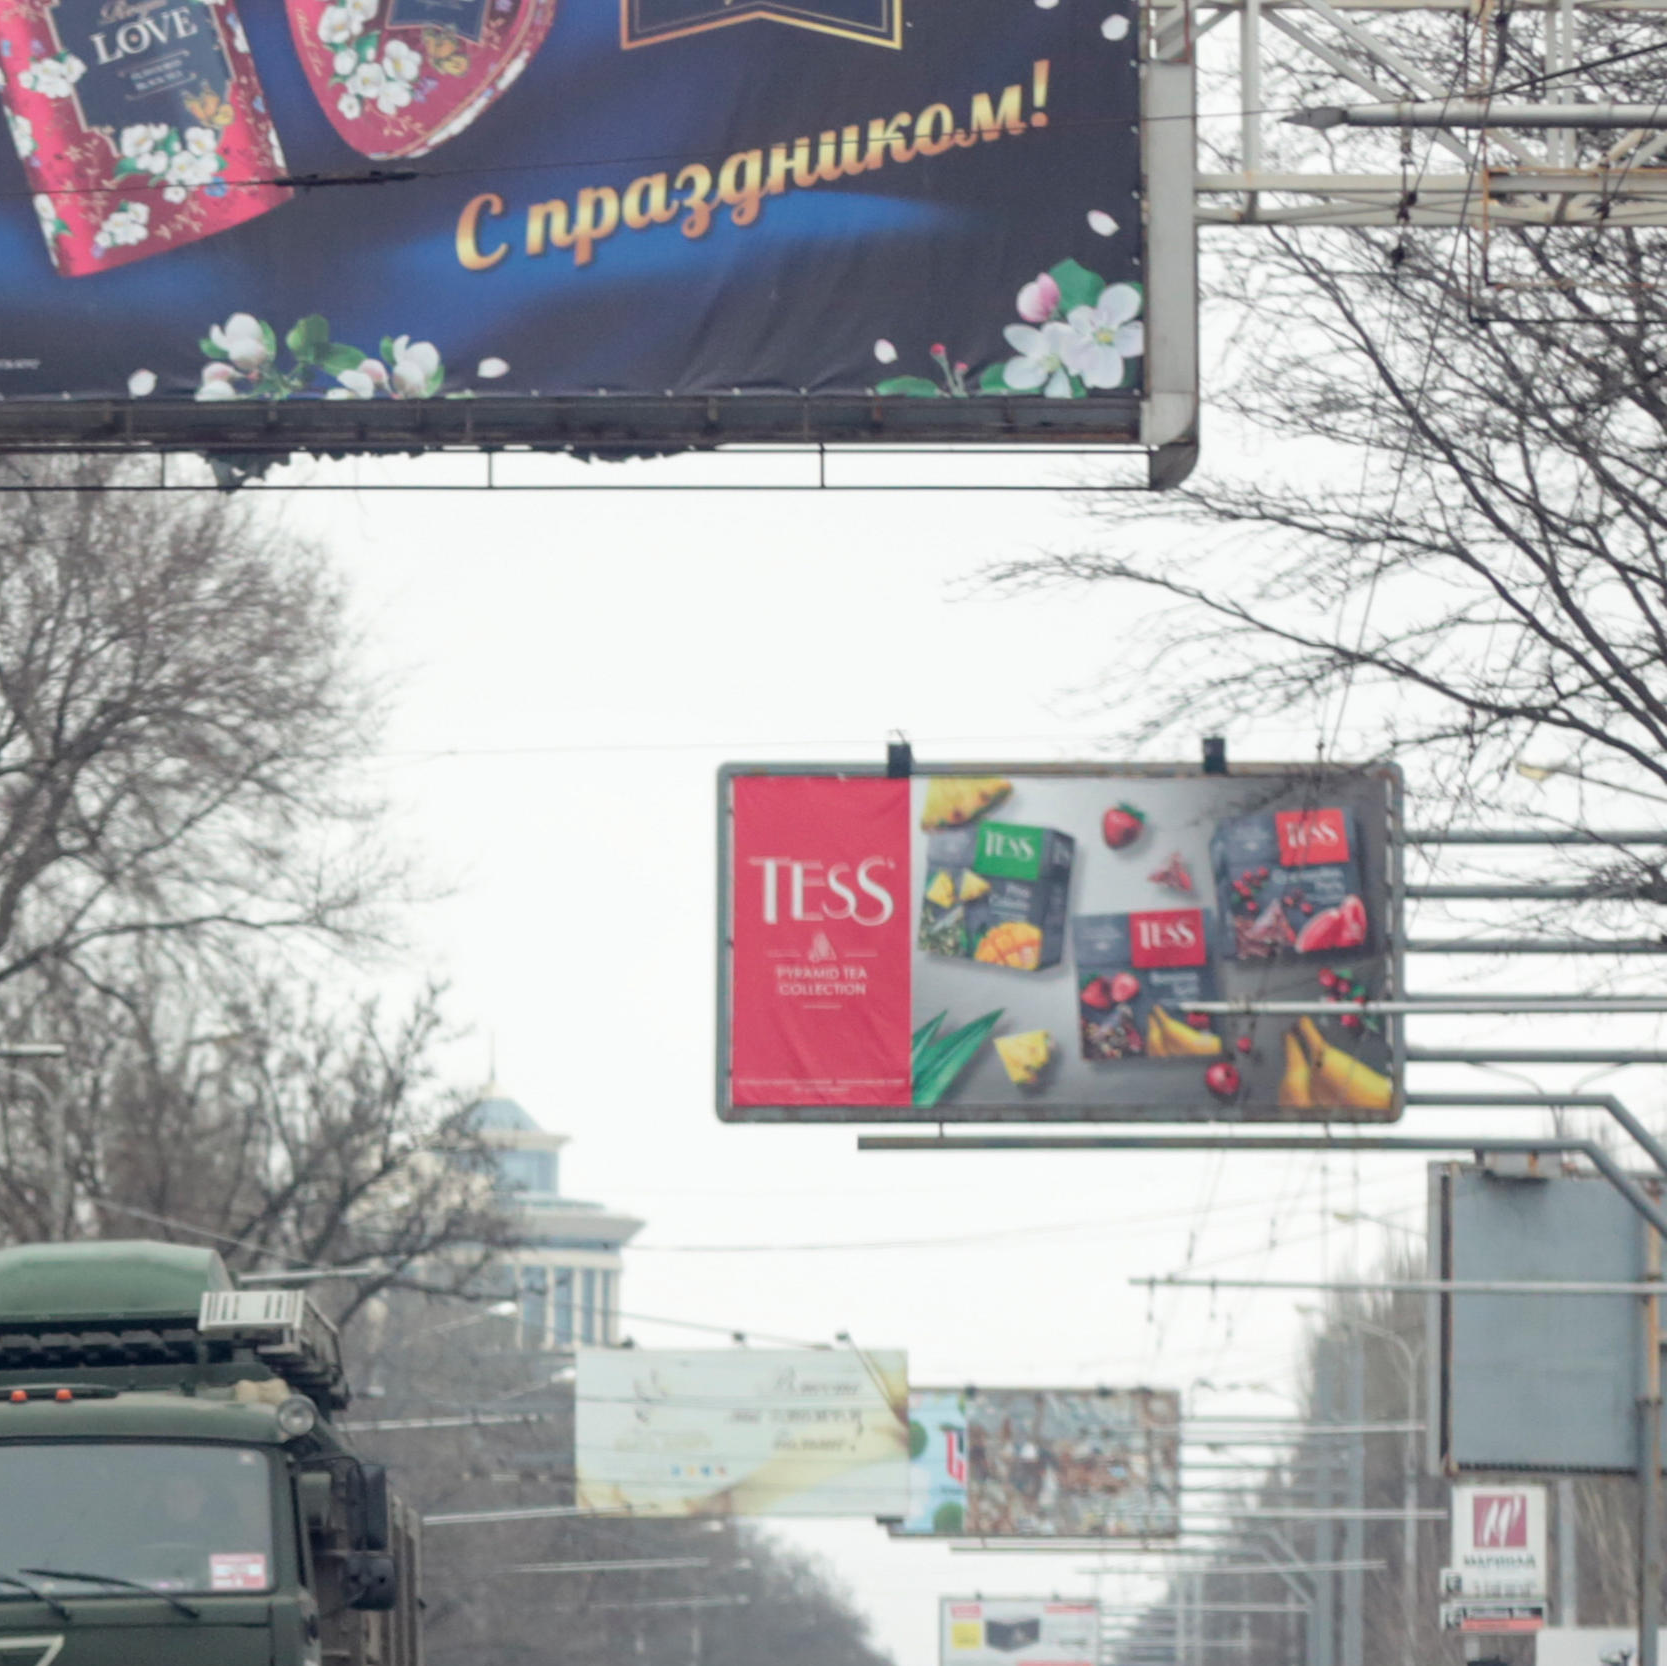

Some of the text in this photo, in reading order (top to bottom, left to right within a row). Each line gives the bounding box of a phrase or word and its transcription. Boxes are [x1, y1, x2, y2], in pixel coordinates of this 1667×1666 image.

[89, 6, 198, 65] LOVE
[455, 59, 1051, 270] С праздником!
[984, 829, 1035, 862] TESS
[748, 856, 894, 927] TESS
[1138, 919, 1196, 949] TESS
[775, 965, 868, 979] PYRAMID TEA
[778, 983, 867, 996] COLLECTION
